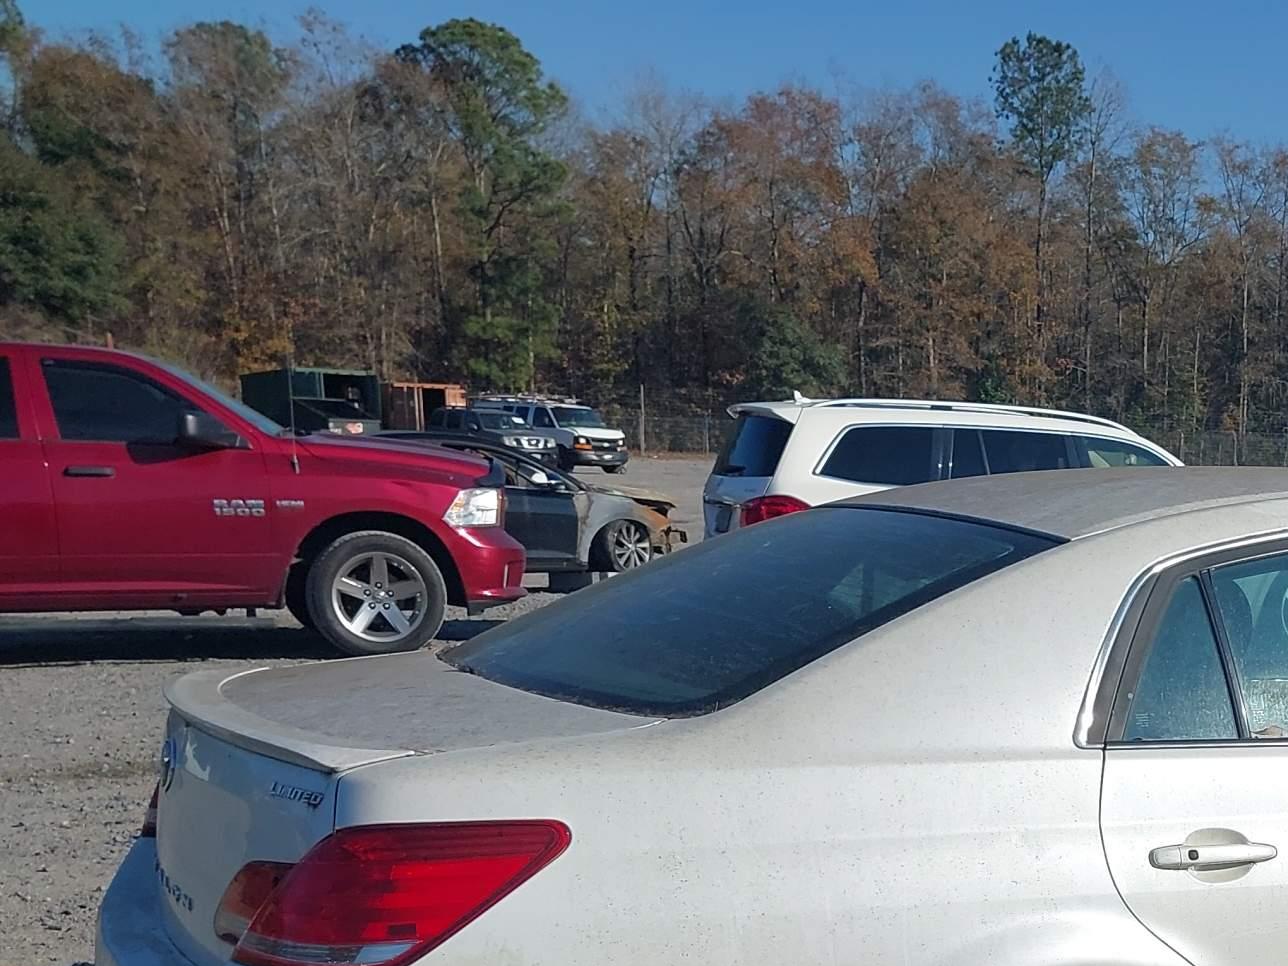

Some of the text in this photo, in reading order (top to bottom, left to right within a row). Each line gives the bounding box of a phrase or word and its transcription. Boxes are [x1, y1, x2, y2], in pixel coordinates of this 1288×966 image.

[213, 499, 265, 508] RAM
[213, 507, 266, 517] 1500
[271, 781, 325, 806] LIMITED
